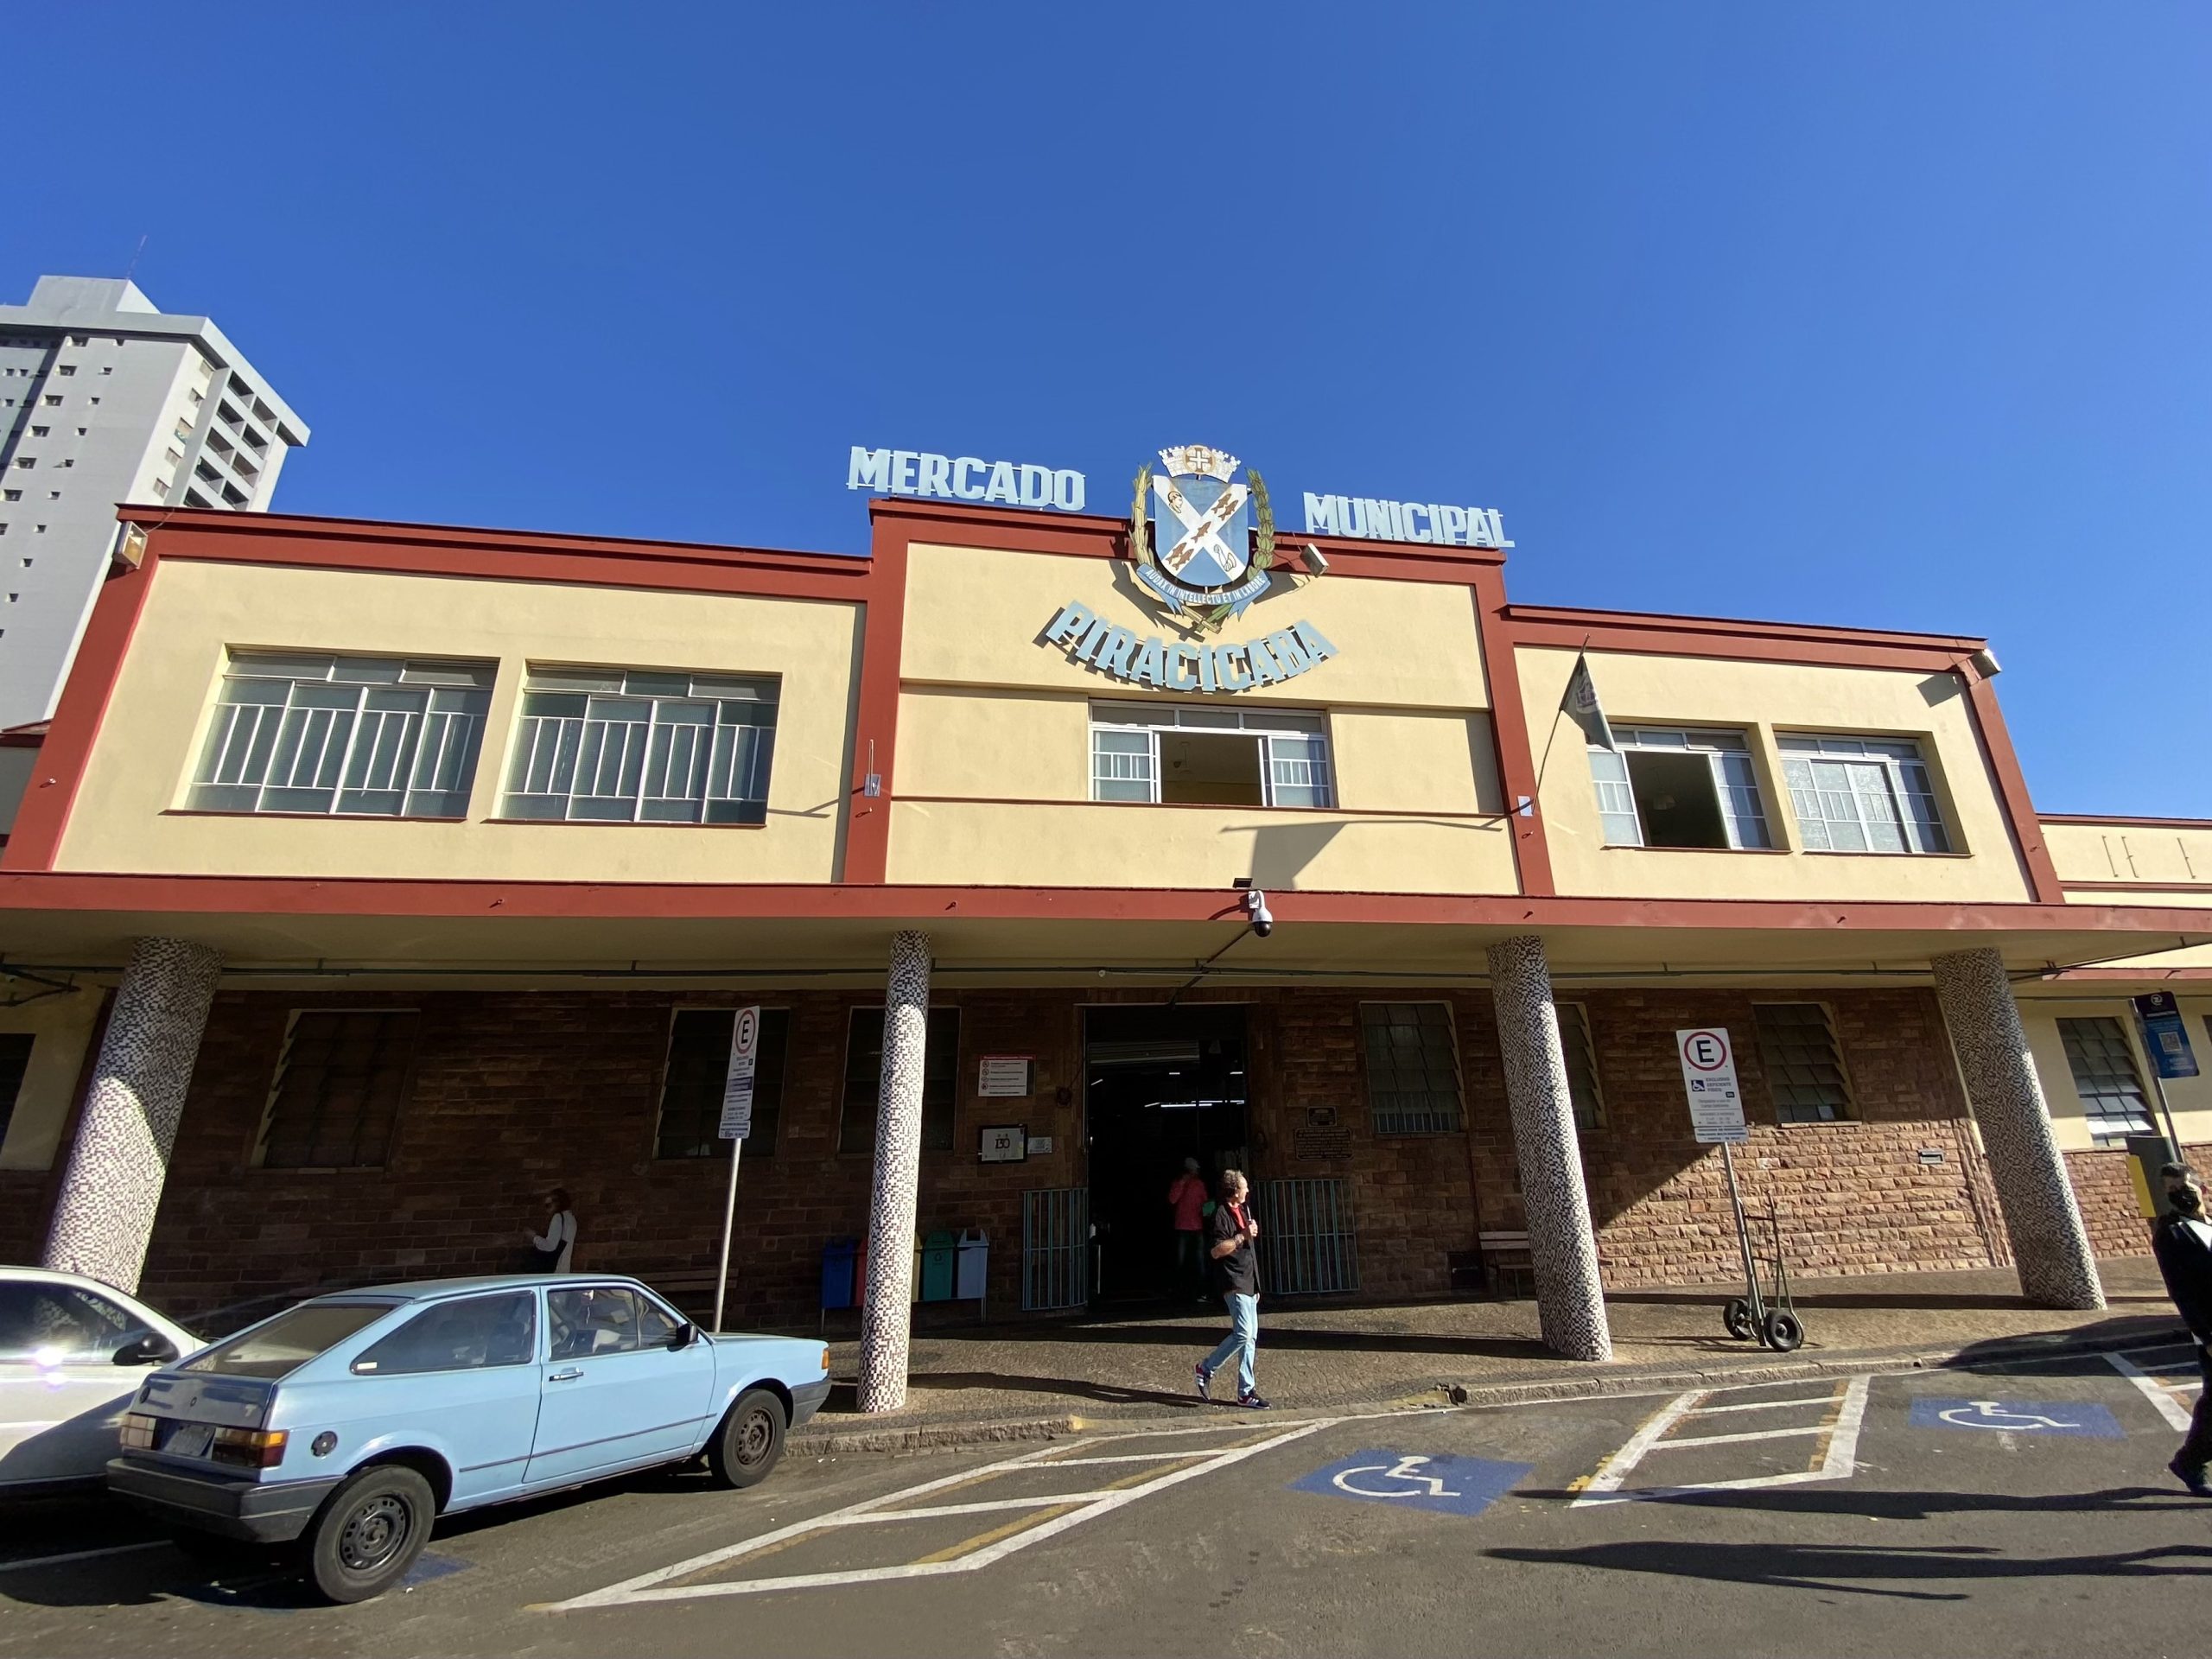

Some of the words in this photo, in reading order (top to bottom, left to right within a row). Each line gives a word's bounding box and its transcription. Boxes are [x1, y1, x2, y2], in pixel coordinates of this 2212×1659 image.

[848, 446, 1085, 511] MERCADO
[1303, 492, 1515, 548] MUNICIPAL
[1145, 569, 1168, 590] AUDAX
[1167, 585, 1176, 596] IN
[1176, 590, 1222, 604] INTELLECTU
[1223, 593, 1233, 603] ET
[1234, 589, 1242, 601] IN
[1242, 575, 1267, 597] LABORE
[1046, 600, 1340, 691] PIRACICABA
[741, 1020, 750, 1044] E
[1696, 1039, 1714, 1063] E
